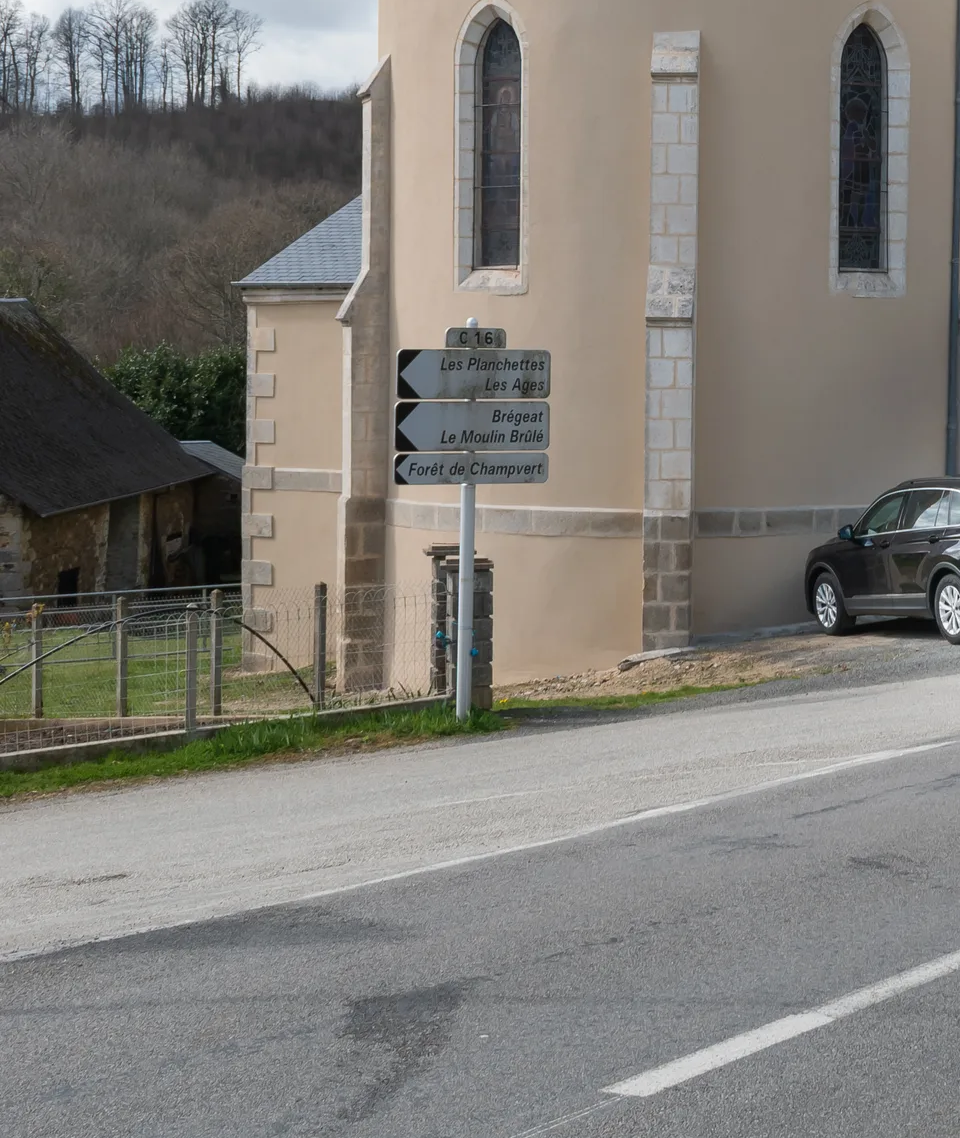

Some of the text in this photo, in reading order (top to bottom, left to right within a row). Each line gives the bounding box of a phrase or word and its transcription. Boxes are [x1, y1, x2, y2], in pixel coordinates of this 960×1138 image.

[460, 332, 493, 344] C 16
[441, 358, 545, 371] Les Planchettes
[485, 378, 544, 394] Les Ages
[492, 410, 543, 426] Brégeat
[441, 430, 543, 444] Le Moulin Brûlé
[408, 462, 542, 478] Forêt de Champvert
